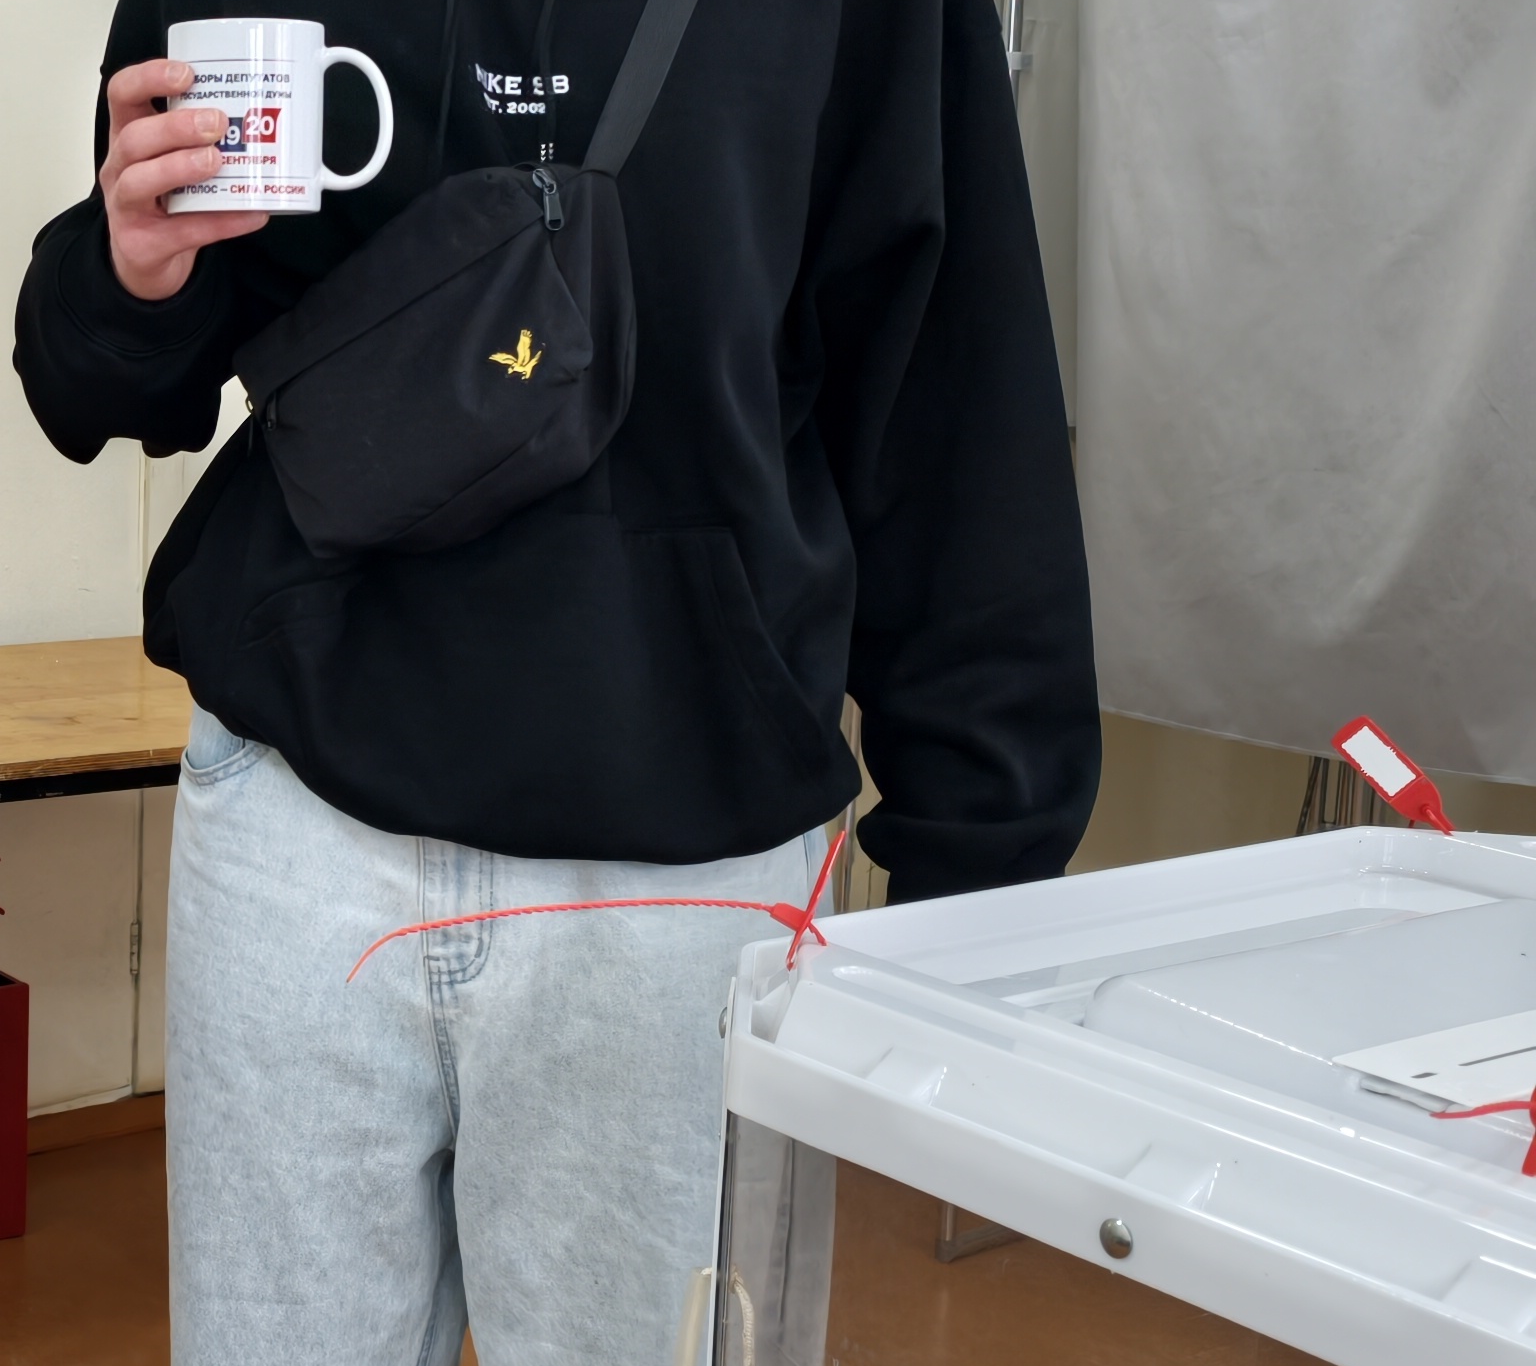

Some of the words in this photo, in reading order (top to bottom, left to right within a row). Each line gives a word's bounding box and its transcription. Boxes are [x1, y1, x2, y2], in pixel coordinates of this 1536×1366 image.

[194, 74, 223, 83] БОРЫ
[246, 115, 275, 136] 20
[186, 185, 218, 194] ГОЛОС
[264, 185, 306, 194] РОССИИ
